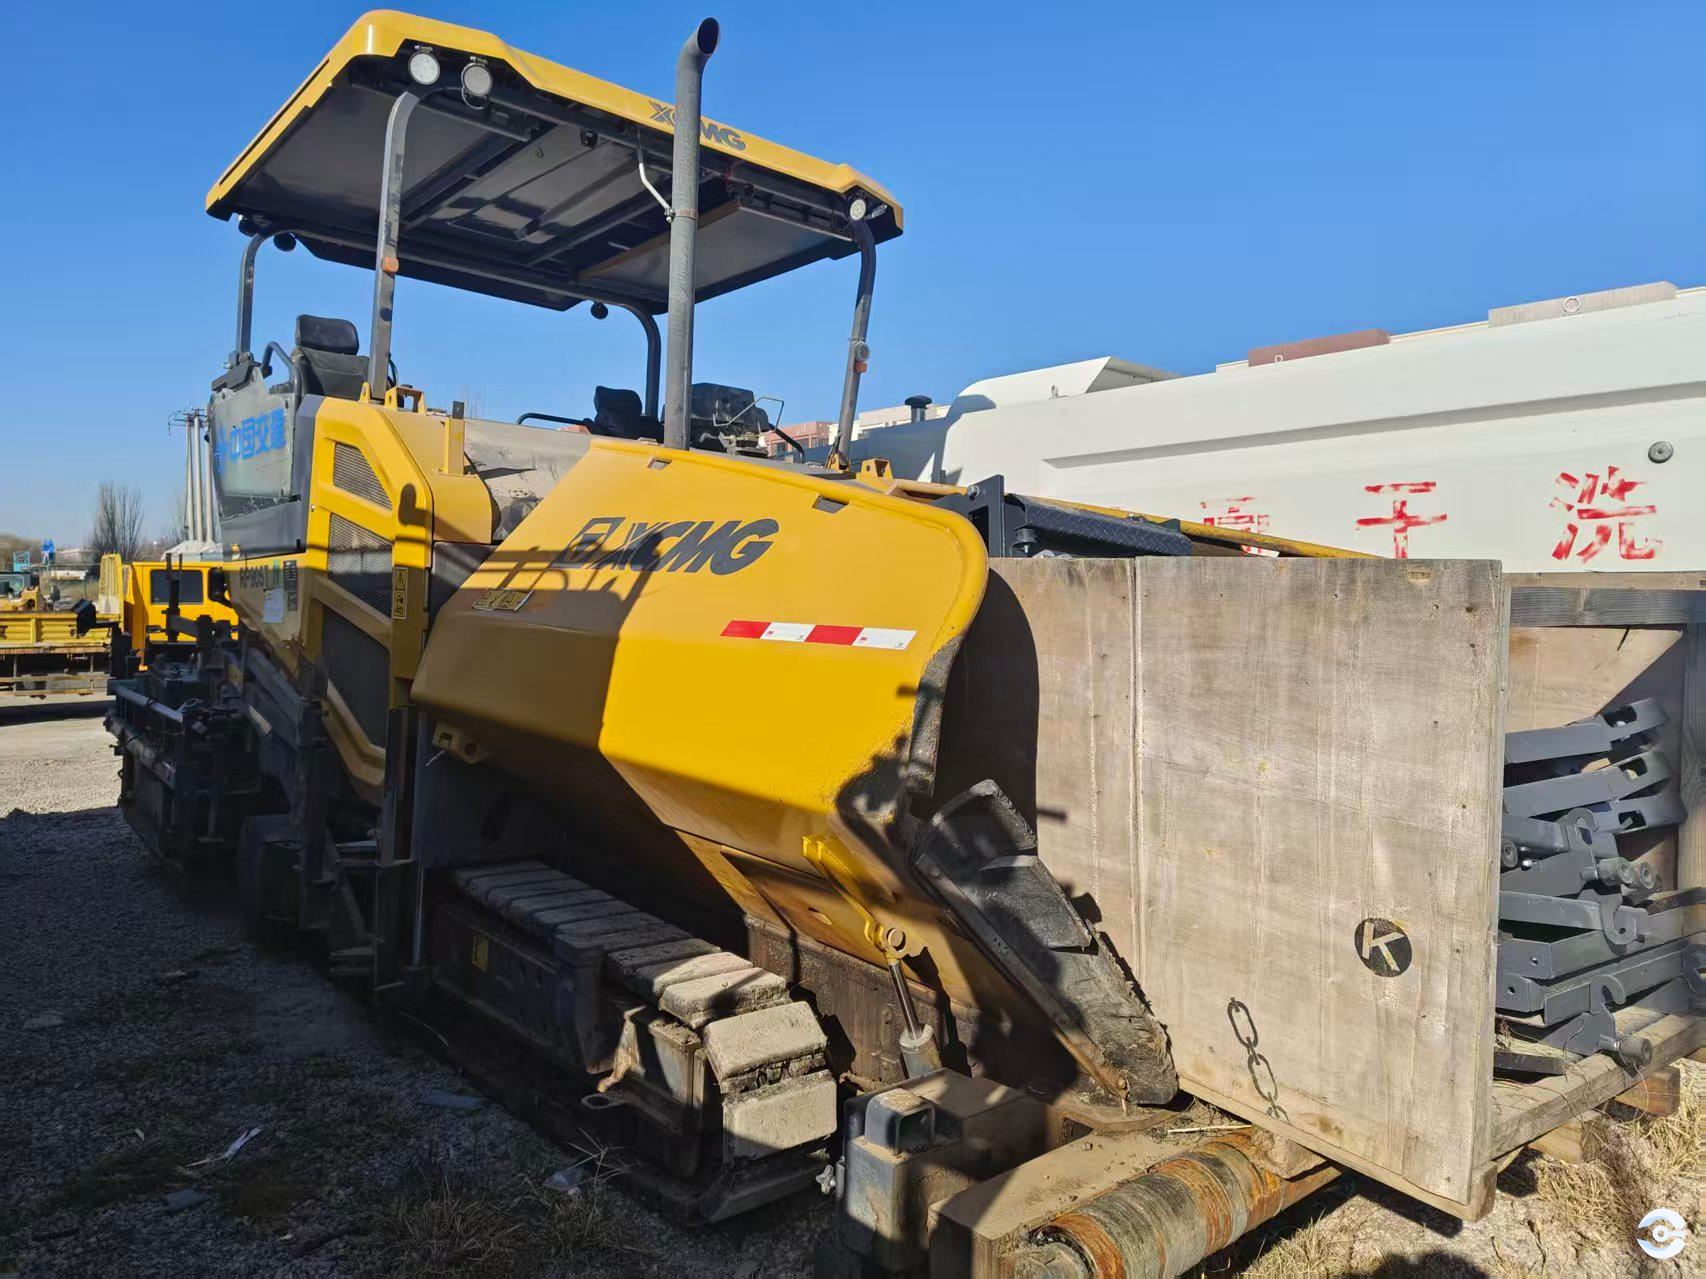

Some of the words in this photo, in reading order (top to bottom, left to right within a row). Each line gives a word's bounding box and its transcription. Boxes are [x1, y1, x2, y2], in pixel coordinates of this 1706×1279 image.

[648, 100, 746, 150] XMG
[586, 518, 779, 575] XCMG
[1361, 921, 1406, 972] K
